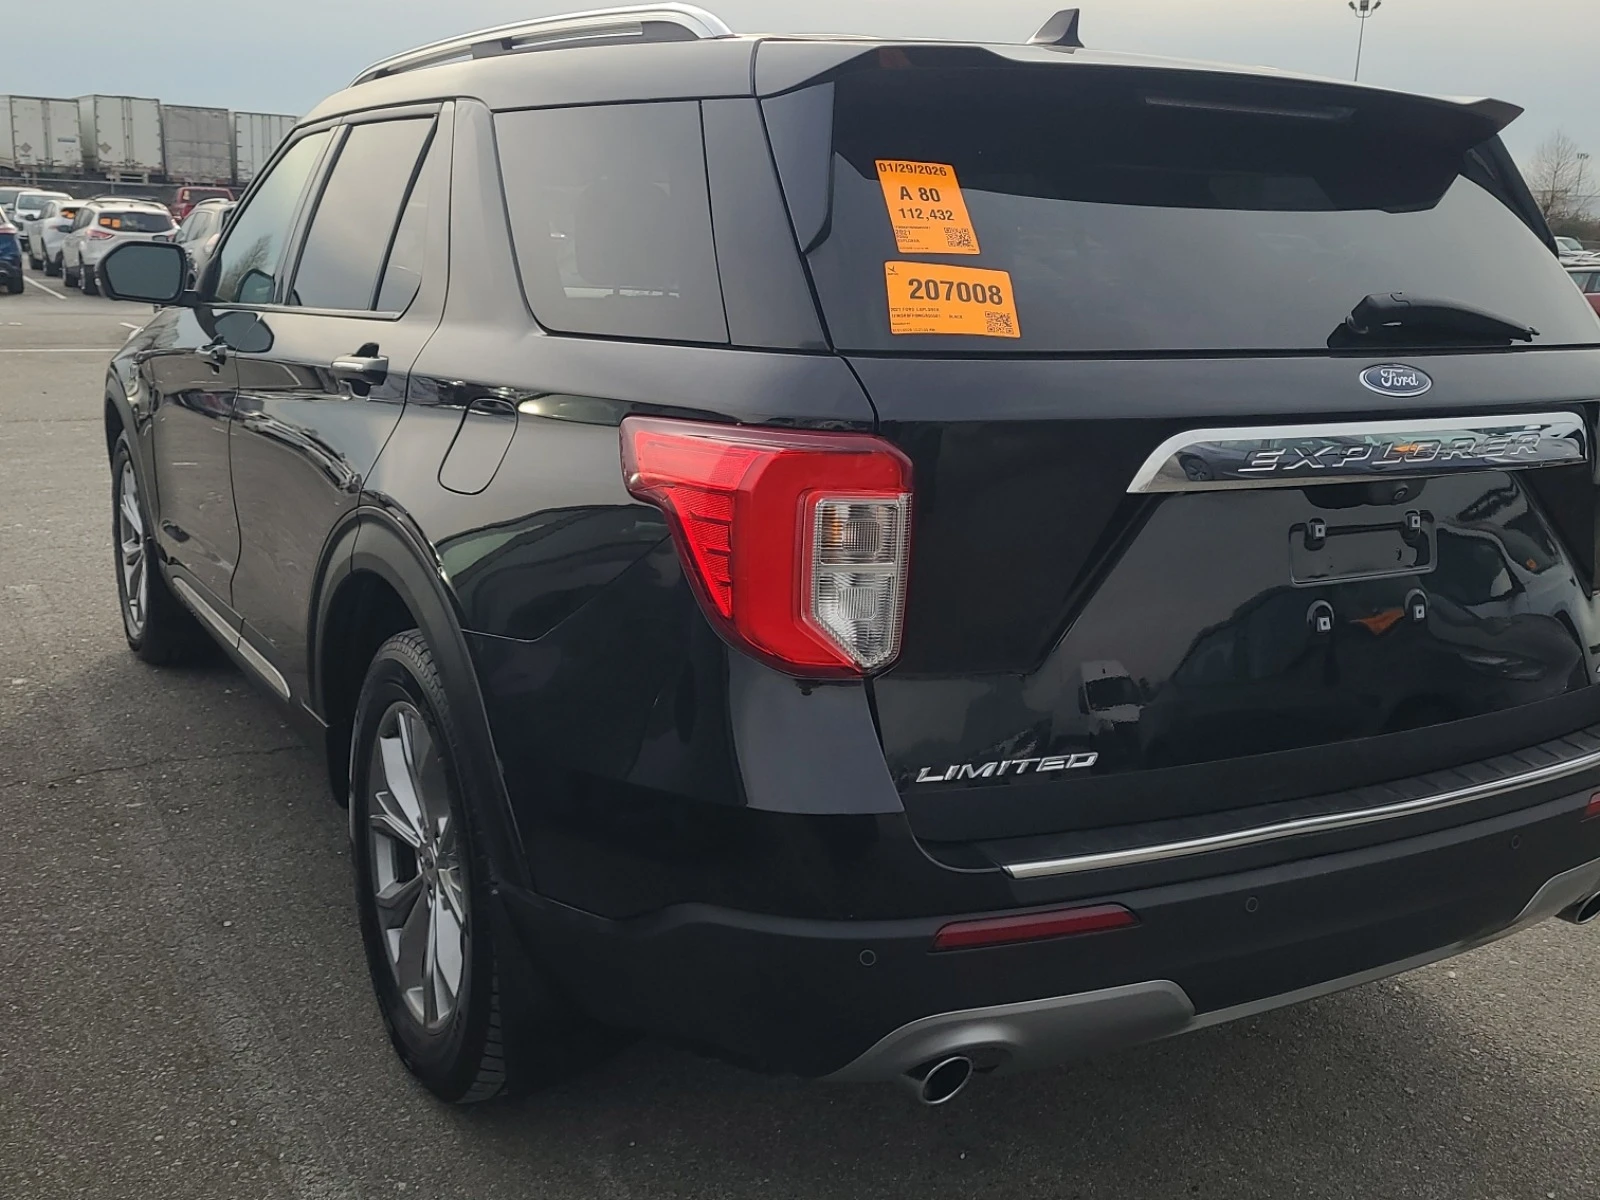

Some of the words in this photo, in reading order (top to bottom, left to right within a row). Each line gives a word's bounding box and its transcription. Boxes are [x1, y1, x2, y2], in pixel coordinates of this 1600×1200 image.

[878, 162, 947, 177] 01/29/2026
[900, 185, 913, 201] A
[918, 187, 941, 202] 80
[899, 207, 955, 221] 112,432
[908, 278, 1003, 306] 207008
[1380, 368, 1419, 387] Ford
[1238, 433, 1543, 472] EXPLORER
[915, 752, 1099, 783] LIMITED
